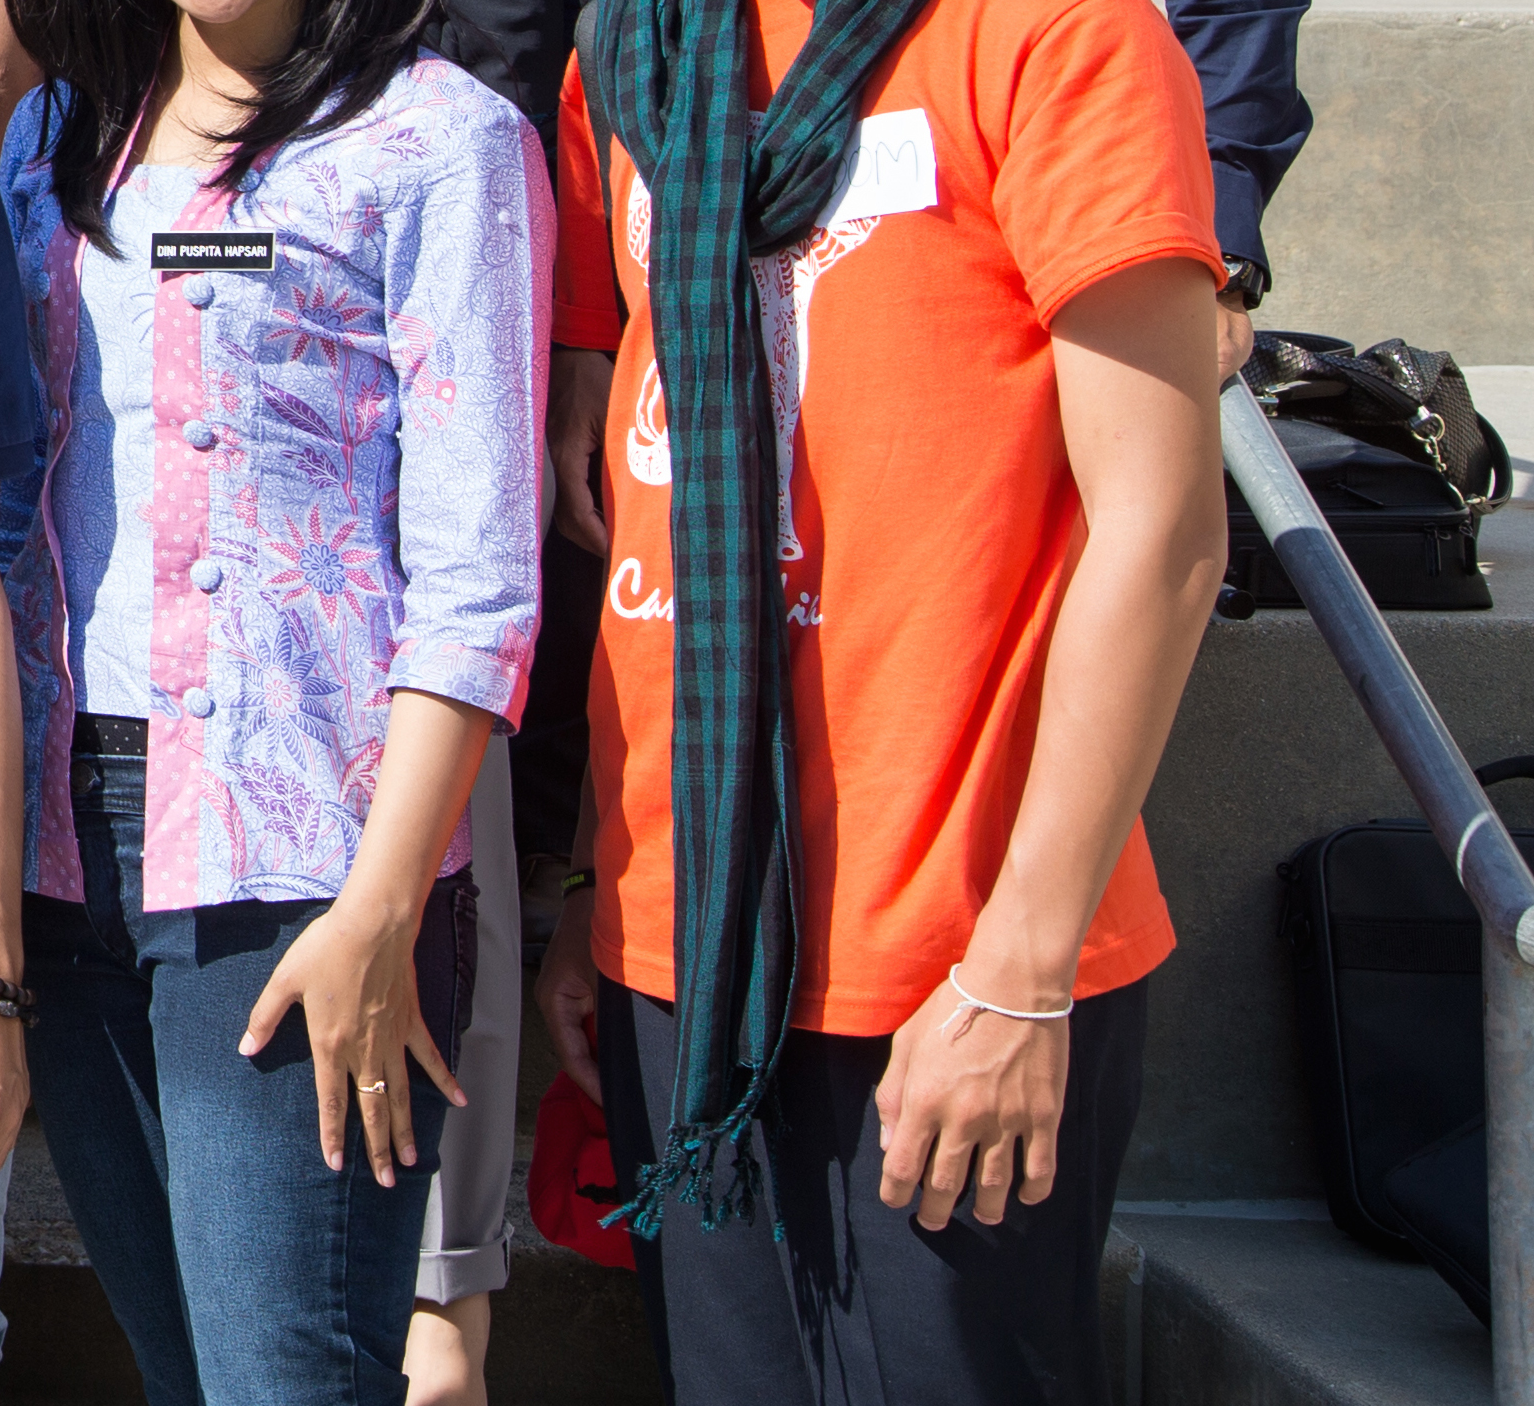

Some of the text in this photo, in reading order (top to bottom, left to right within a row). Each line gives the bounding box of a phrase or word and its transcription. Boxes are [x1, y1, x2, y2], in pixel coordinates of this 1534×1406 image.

[156, 245, 268, 257] DINI PUSPITA HAPSARI
